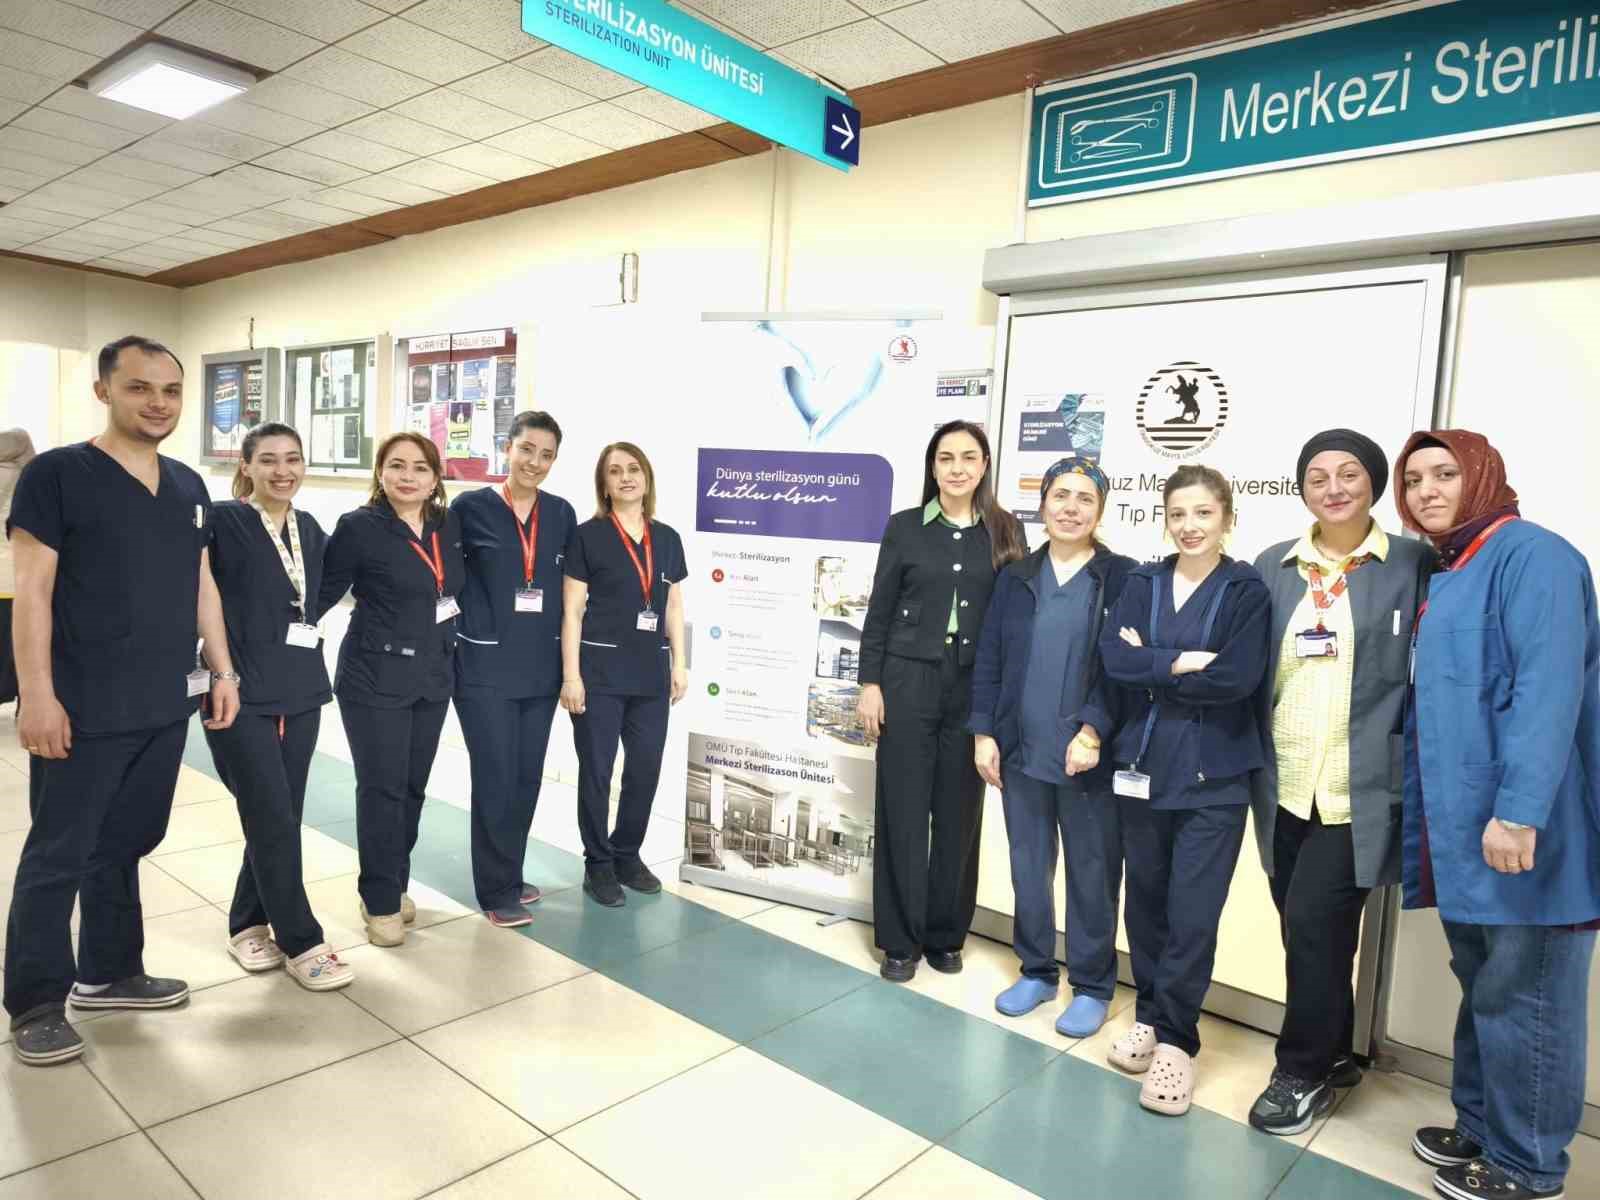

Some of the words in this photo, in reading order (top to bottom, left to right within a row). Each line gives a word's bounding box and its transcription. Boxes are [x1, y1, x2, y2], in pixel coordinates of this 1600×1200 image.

[545, 0, 640, 56] STERILIZATION
[644, 47, 672, 70] UNIT
[702, 43, 764, 97] ÜNİTESİ
[1220, 51, 1413, 143] Merkezi
[1431, 14, 1600, 104] Sterili
[716, 467, 752, 482] Dünya
[755, 470, 825, 484] sterilizasyon
[827, 473, 860, 488] günü
[706, 481, 772, 500] kutlu
[773, 486, 837, 505] olsun
[1117, 503, 1145, 527] Tıp
[745, 746, 783, 761] Fakültesi
[705, 754, 742, 769] Merkezi
[743, 760, 798, 779] Sterilizason
[800, 768, 835, 784] Ünitesi
